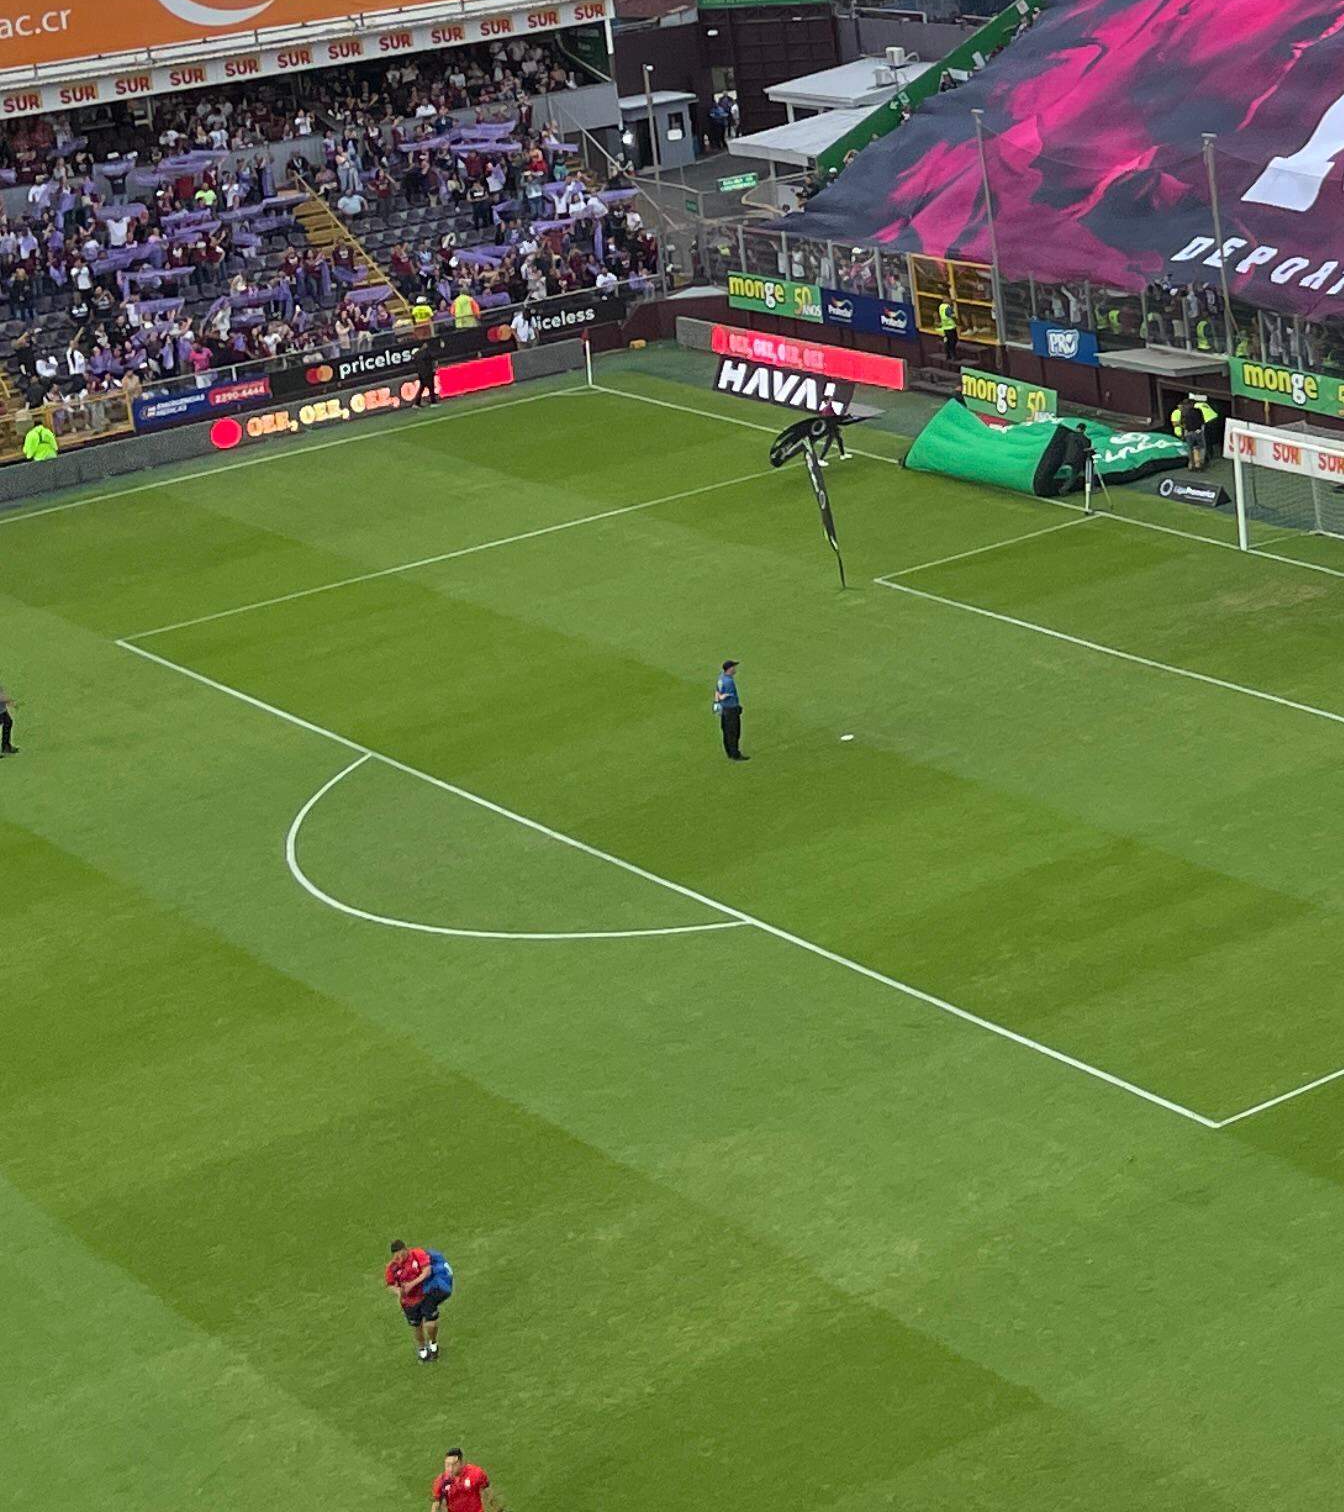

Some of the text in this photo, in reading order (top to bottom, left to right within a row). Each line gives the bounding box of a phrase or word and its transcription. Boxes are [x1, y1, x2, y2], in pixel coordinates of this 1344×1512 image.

[3, 4, 605, 113] SUR SUR SUR SUR SUR SUR SUR SUR SUR SUR SUR SUR
[728, 276, 785, 310] monge
[793, 287, 813, 315] 50
[717, 359, 844, 416] HAVAL
[961, 372, 1018, 415] monge
[1242, 362, 1318, 405] monge
[1026, 390, 1046, 421] 50
